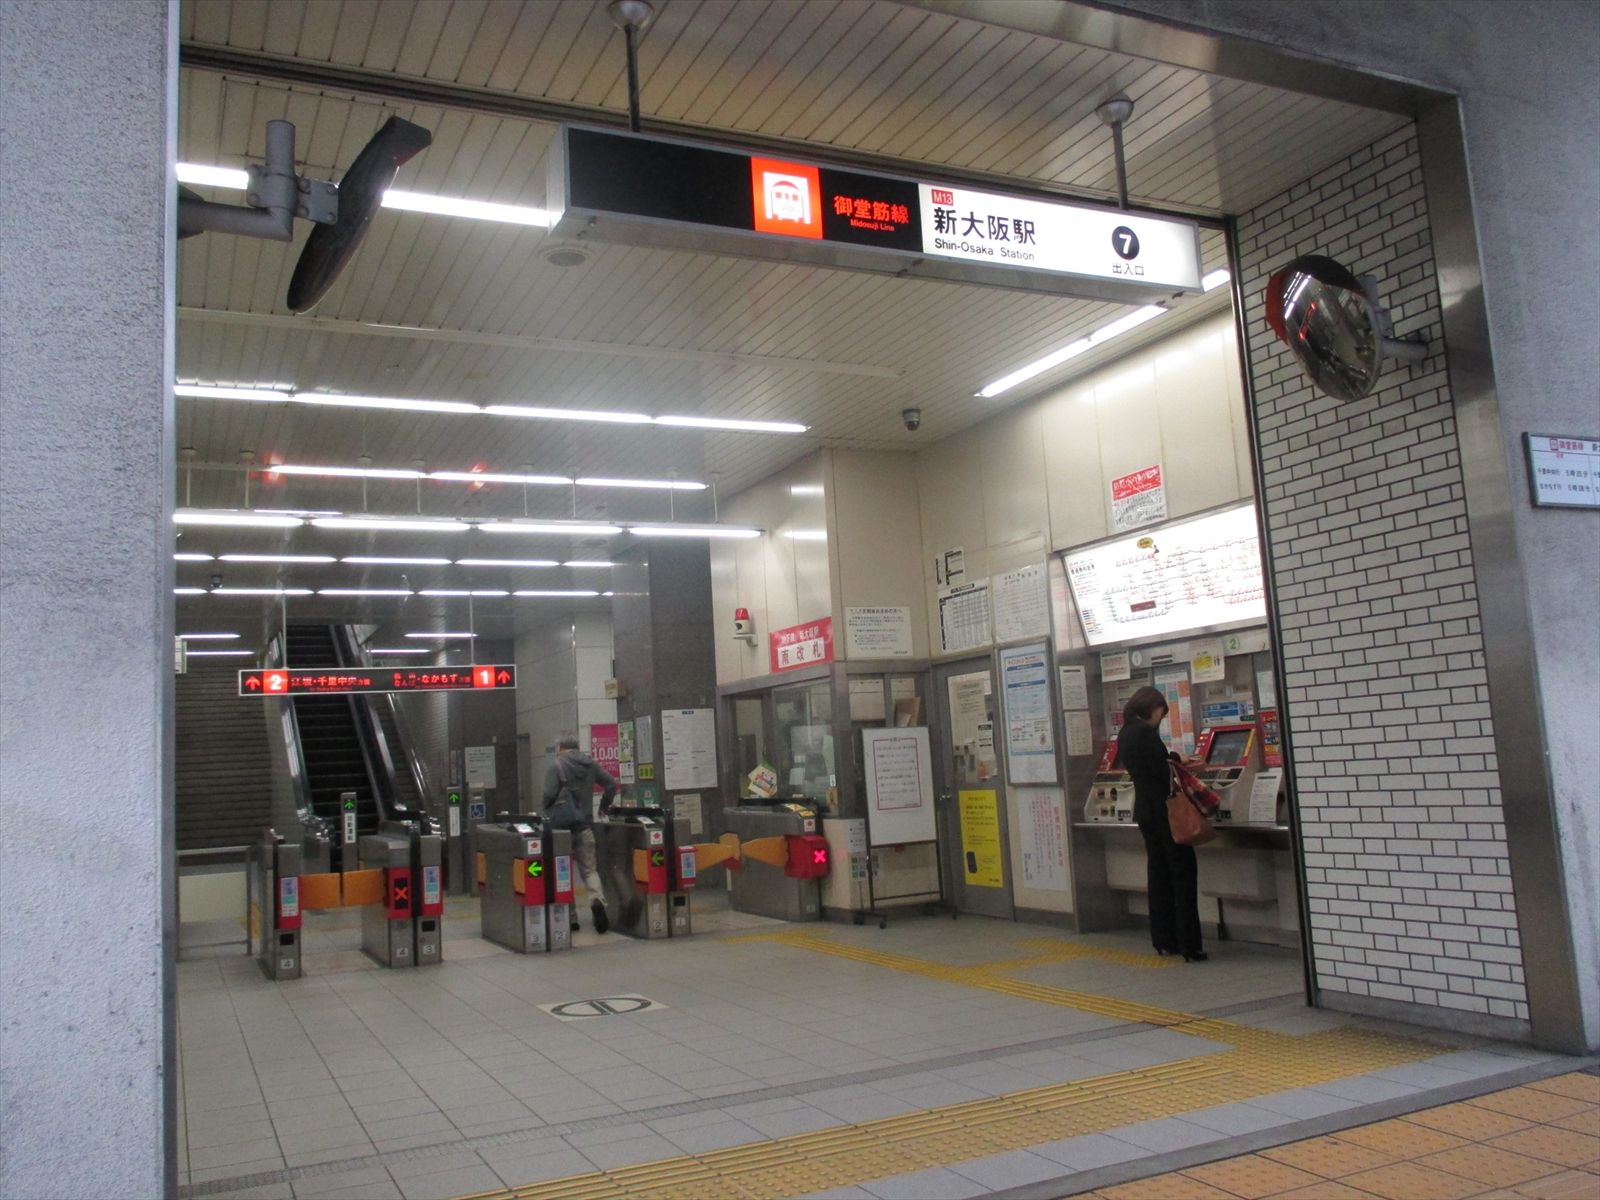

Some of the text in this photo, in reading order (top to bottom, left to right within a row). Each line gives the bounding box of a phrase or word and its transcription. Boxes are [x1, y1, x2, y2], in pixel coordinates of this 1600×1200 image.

[933, 191, 953, 205] M13
[834, 195, 909, 224] 御堂筋線
[850, 219, 895, 231] Midosuji Line
[934, 207, 1036, 245] 新大阪駅
[934, 238, 1035, 261] Shin-Osaka Station
[1119, 233, 1132, 254] 7
[1111, 262, 1145, 276] 出入口
[270, 674, 282, 690] 2
[480, 669, 490, 685] 1
